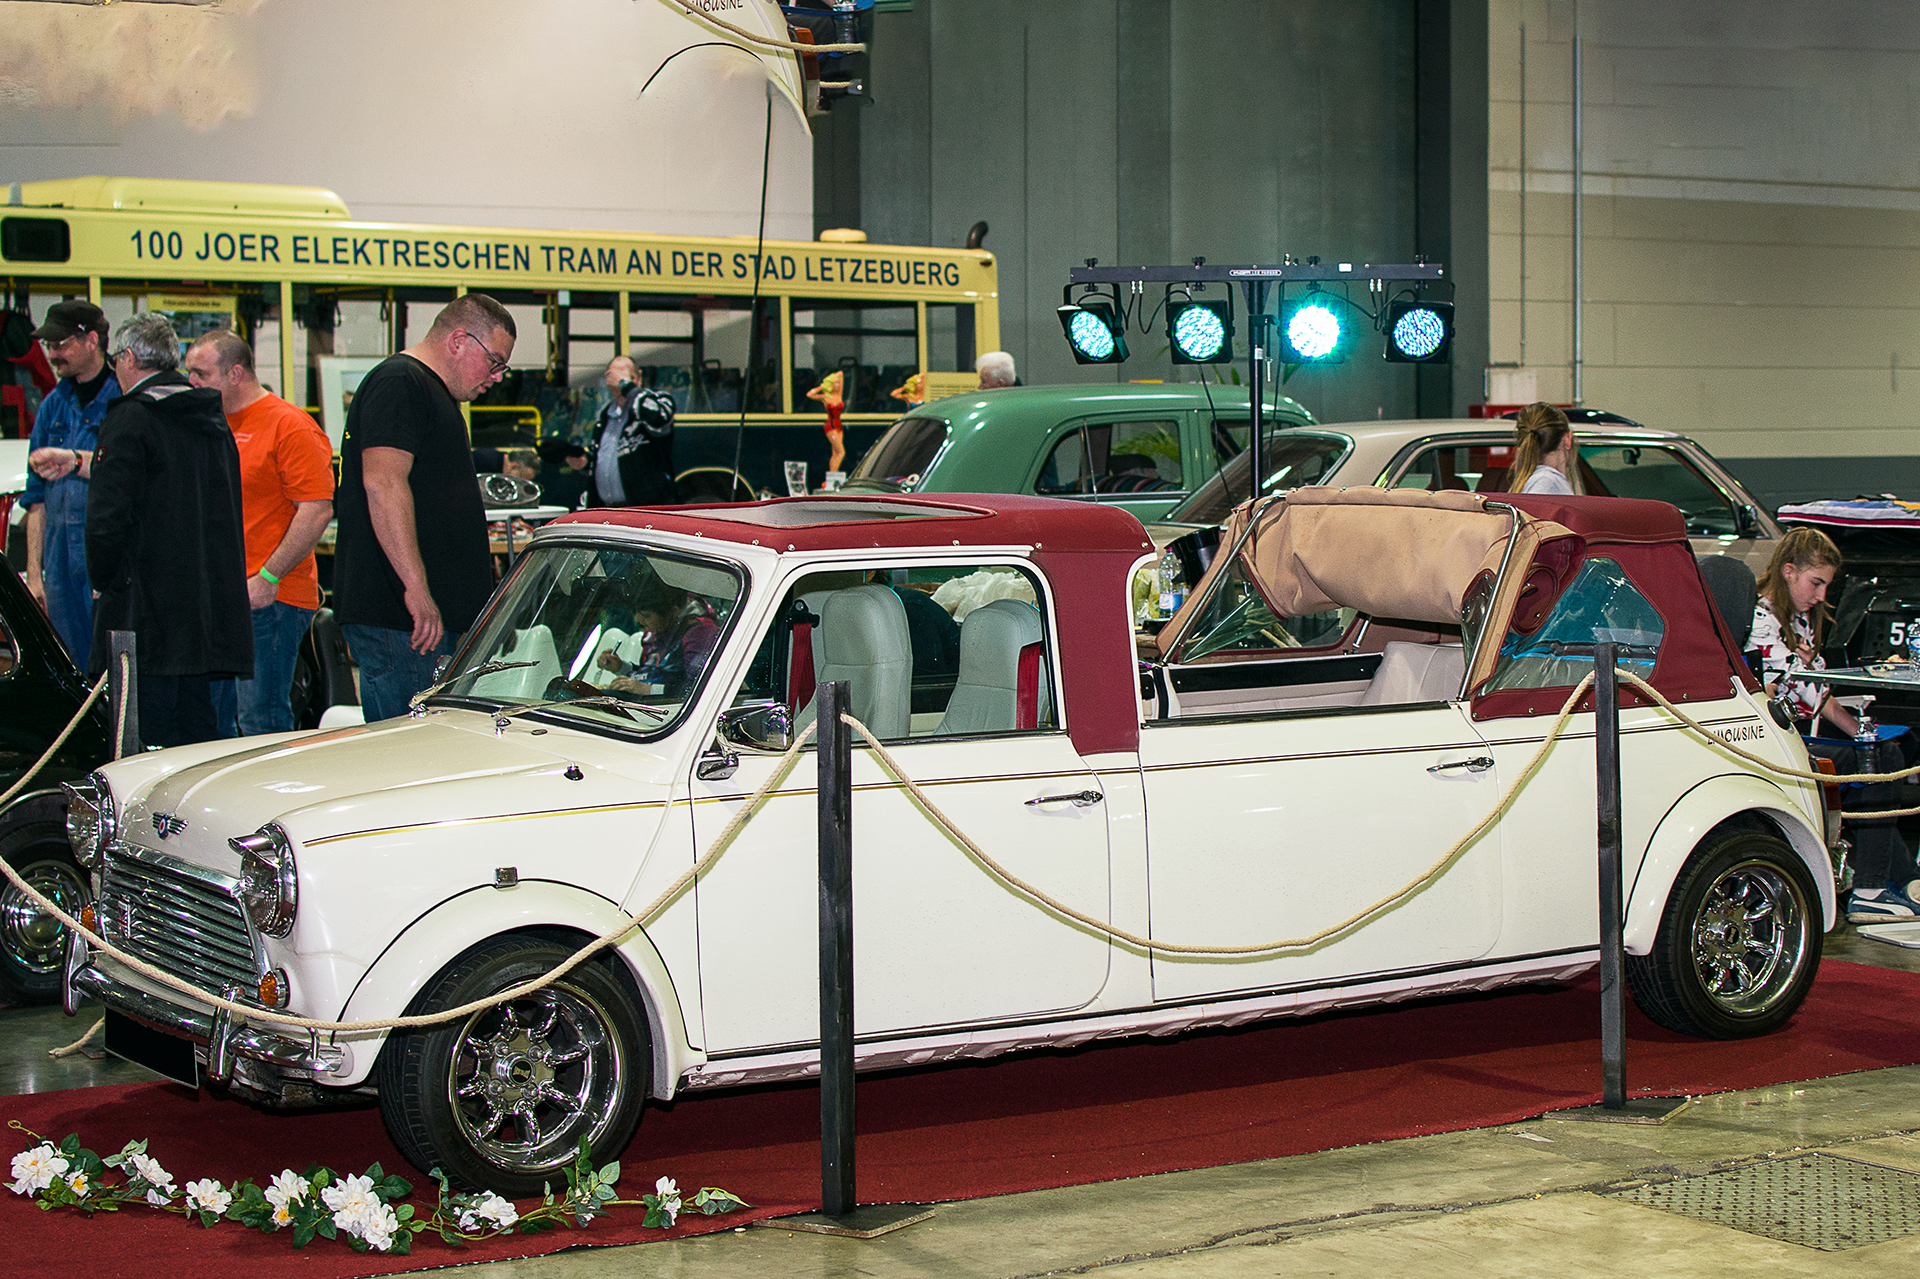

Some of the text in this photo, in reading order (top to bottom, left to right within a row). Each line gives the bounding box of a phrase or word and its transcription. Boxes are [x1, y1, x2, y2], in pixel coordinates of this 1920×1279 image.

[130, 229, 960, 287] 100 JOER ELEKTRESCHEN TRAM AN DER STAD LETZEBUERG
